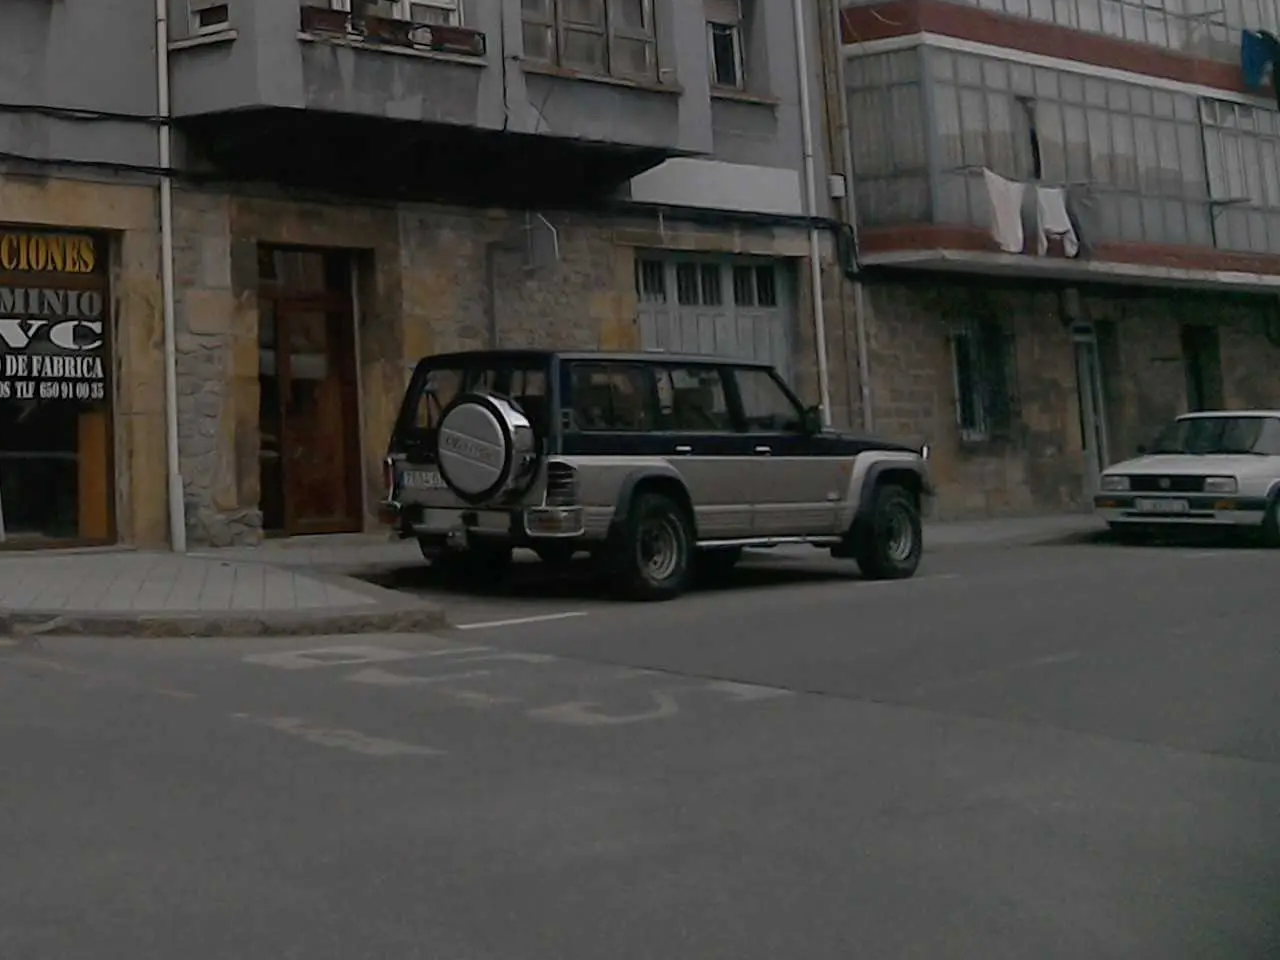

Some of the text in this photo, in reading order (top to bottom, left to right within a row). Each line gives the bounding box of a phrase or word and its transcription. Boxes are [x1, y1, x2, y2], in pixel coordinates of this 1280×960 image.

[5, 354, 28, 377] DE
[31, 355, 104, 378] FABRICA
[39, 382, 59, 399] 650
[61, 382, 74, 399] 91
